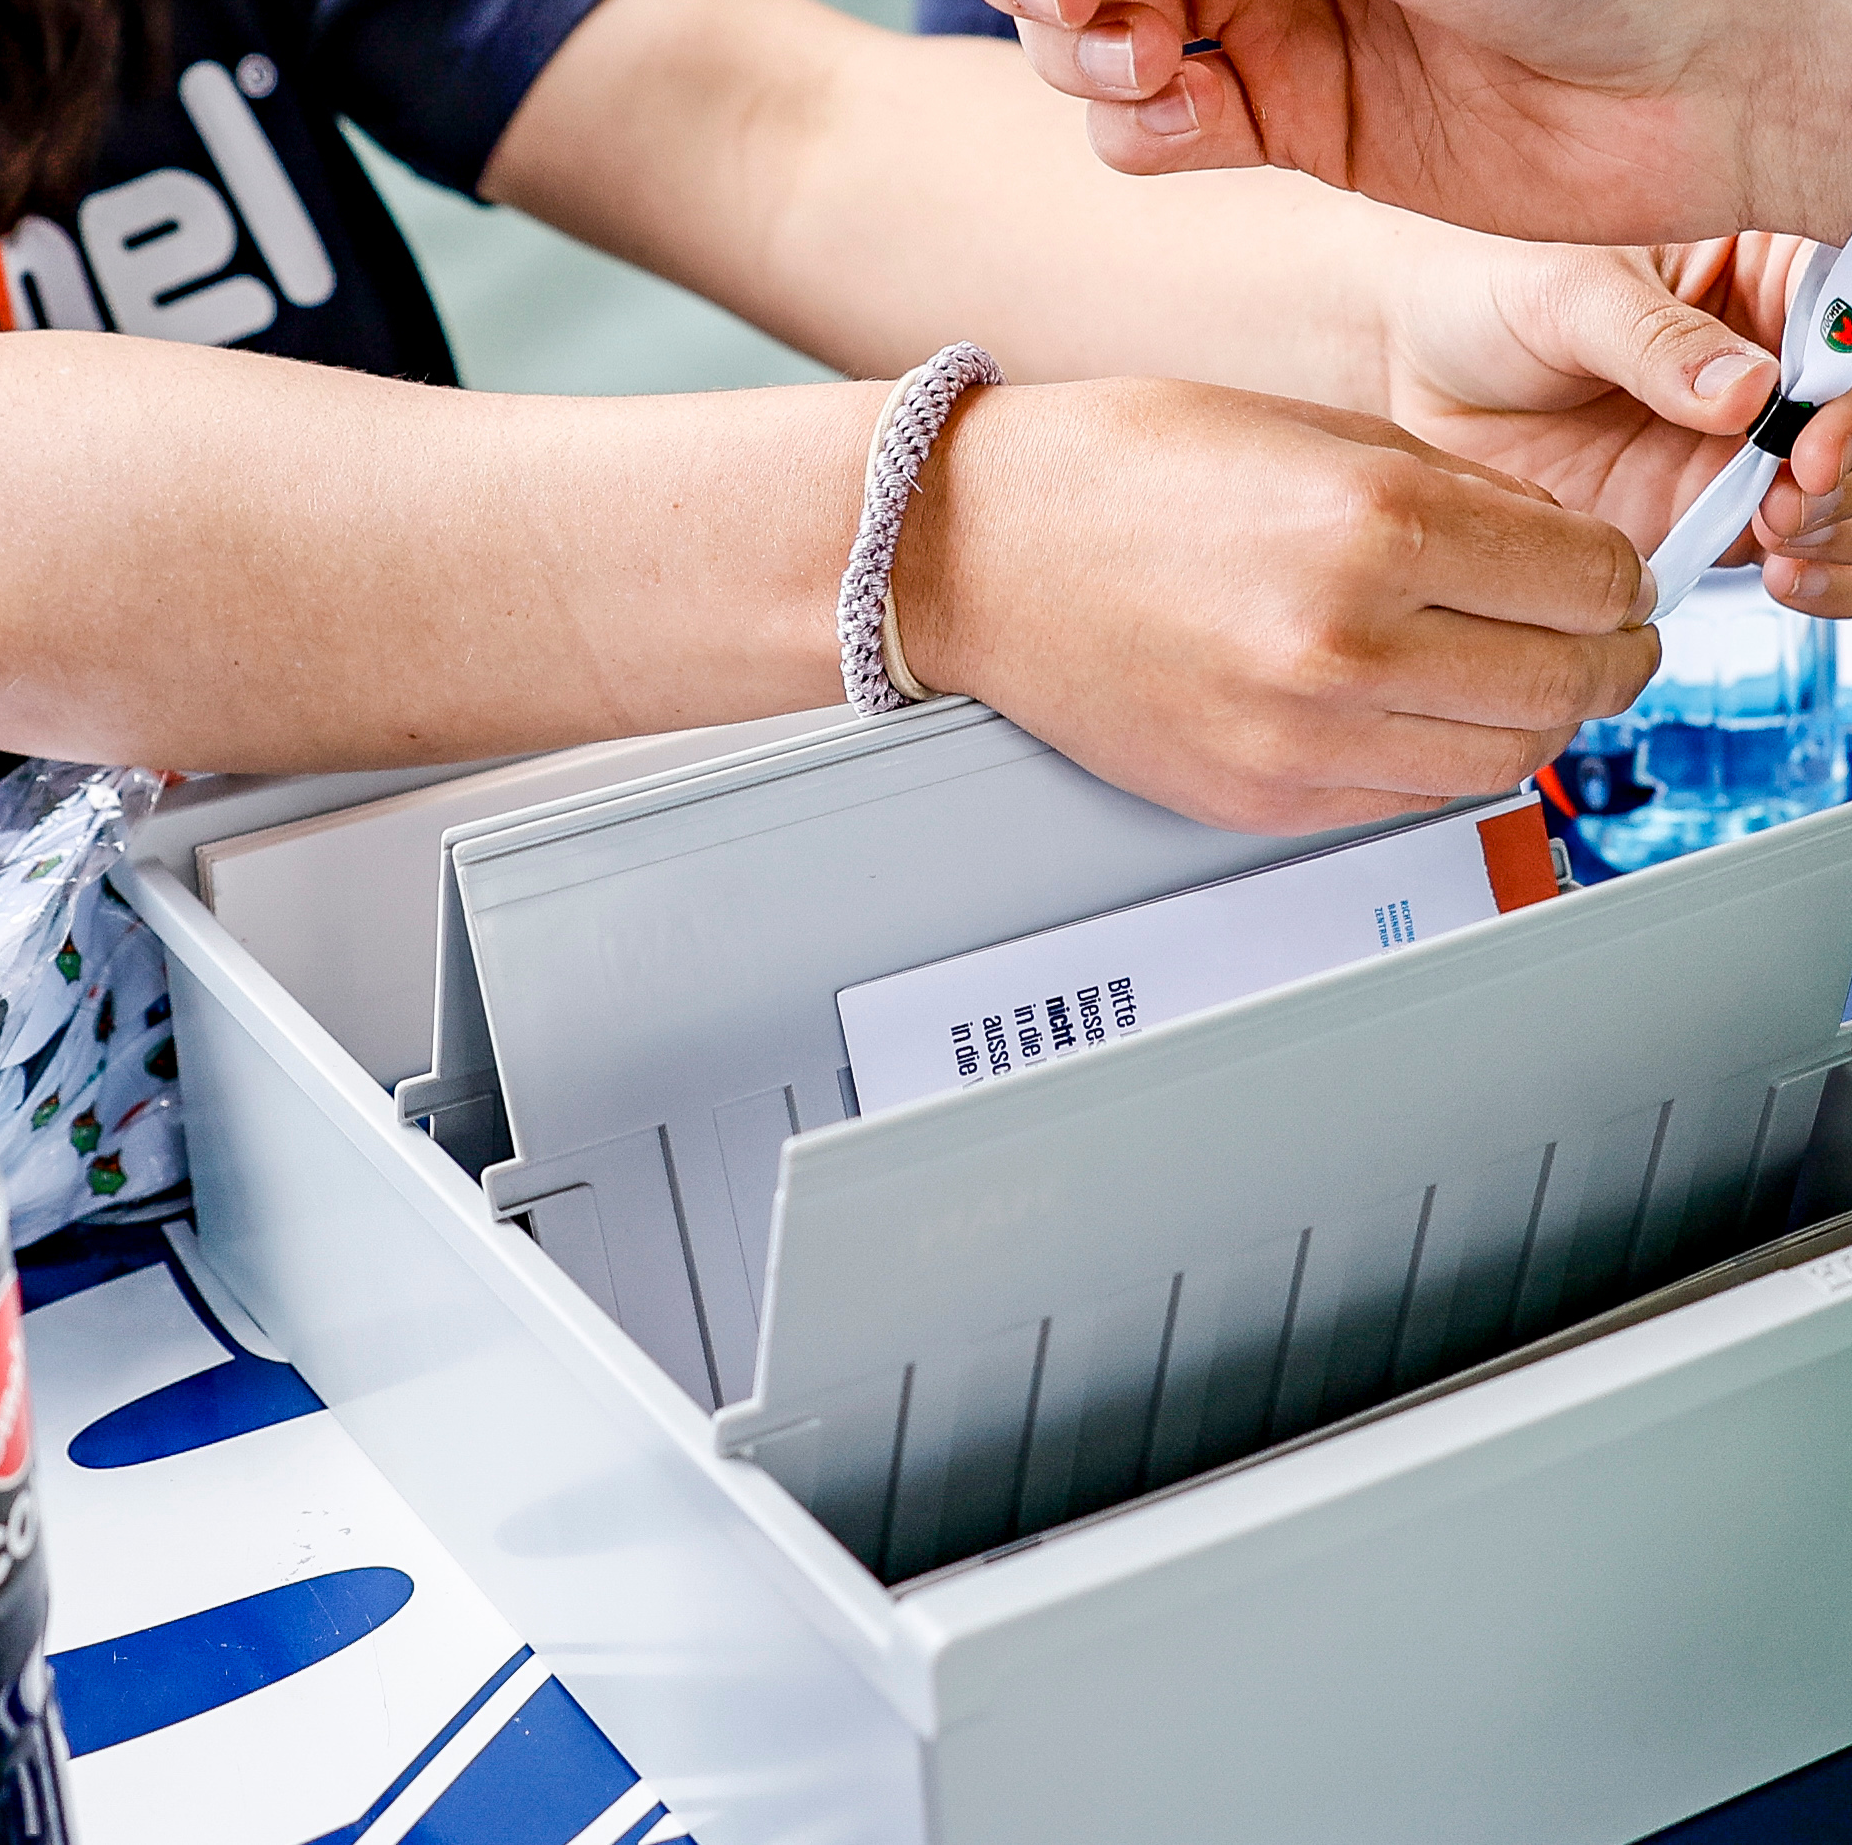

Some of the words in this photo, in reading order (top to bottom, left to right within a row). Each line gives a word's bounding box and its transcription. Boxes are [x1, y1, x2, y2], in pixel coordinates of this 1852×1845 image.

[1014, 1003, 1037, 1026] in
[1107, 977, 1137, 1028] Bitte
[951, 1021, 973, 1044] in
[1045, 995, 1077, 1051] nicht
[1018, 1026, 1043, 1058] die
[955, 1044, 980, 1076] die
